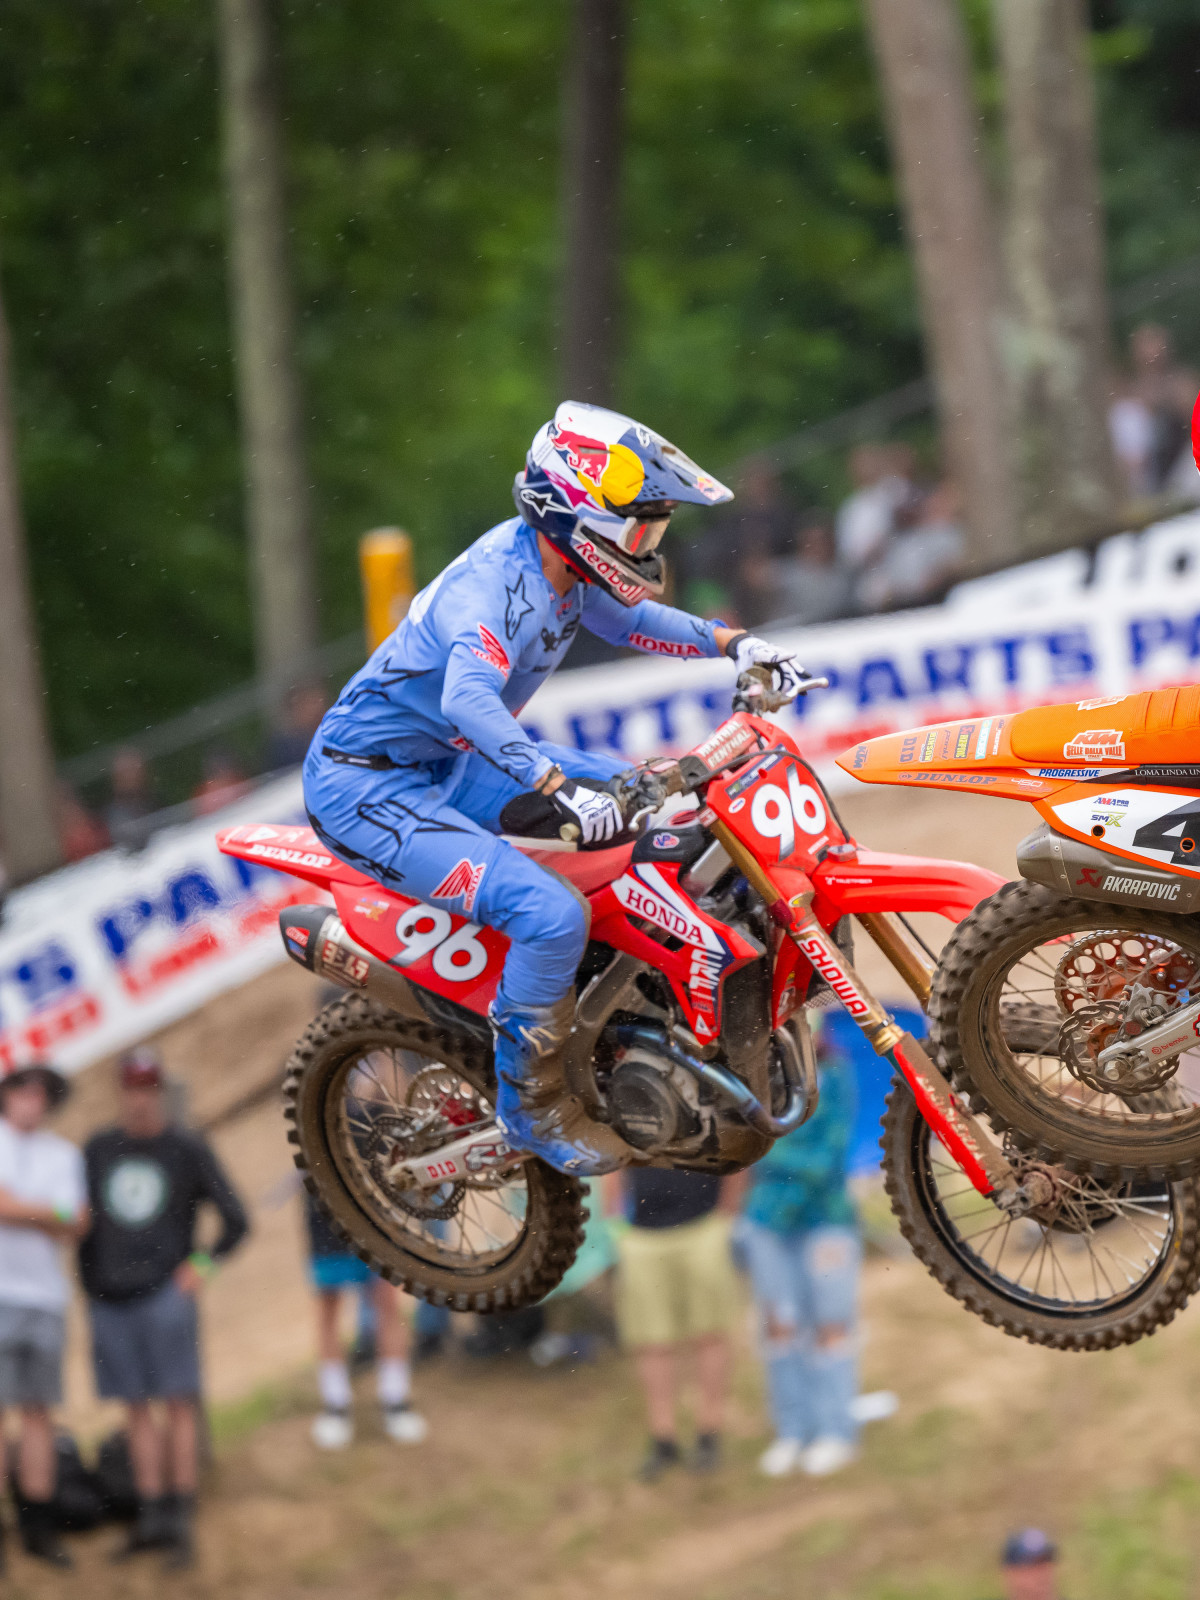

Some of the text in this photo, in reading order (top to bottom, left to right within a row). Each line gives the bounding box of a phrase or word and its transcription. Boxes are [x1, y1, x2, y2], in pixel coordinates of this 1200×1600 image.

[707, 728, 752, 769] RENTHAL
[1072, 732, 1119, 744] KTM
[913, 772, 998, 785] DUNLOP
[1011, 777, 1044, 788] 450
[1038, 768, 1101, 778] PROGRESSIVE
[1134, 769, 1160, 777] LOMA
[1161, 769, 1188, 777] LINDA
[751, 761, 827, 863] 96
[246, 844, 333, 868] DUNLOP
[464, 863, 486, 911] HONDA
[625, 886, 708, 946] HONDA
[387, 904, 488, 982] 96
[800, 937, 871, 1018] SHOWA
